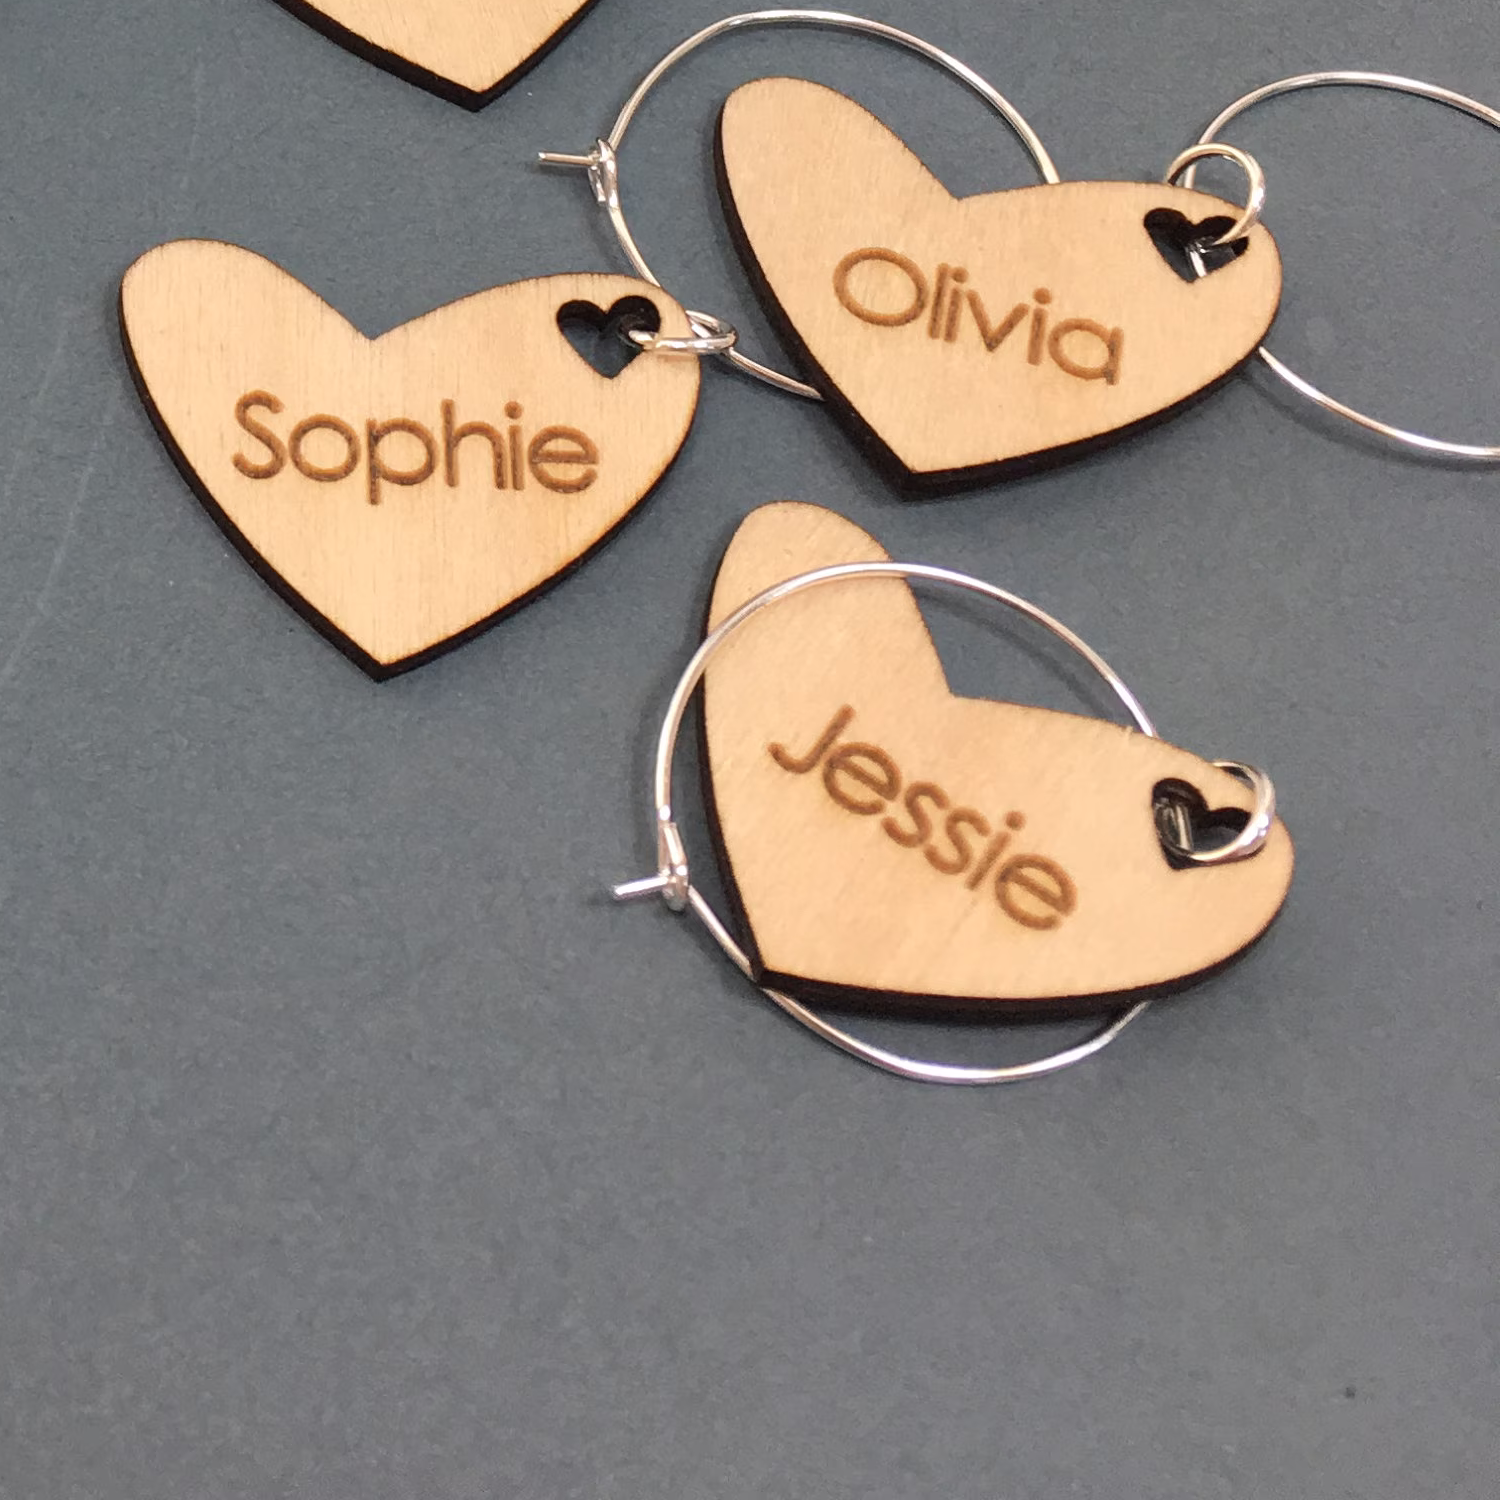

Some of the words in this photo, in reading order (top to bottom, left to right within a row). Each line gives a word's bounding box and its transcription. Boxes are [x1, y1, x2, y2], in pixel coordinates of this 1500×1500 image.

[832, 246, 1125, 386] Olivia
[231, 389, 600, 505] Sophie
[766, 703, 1079, 931] Jessie
